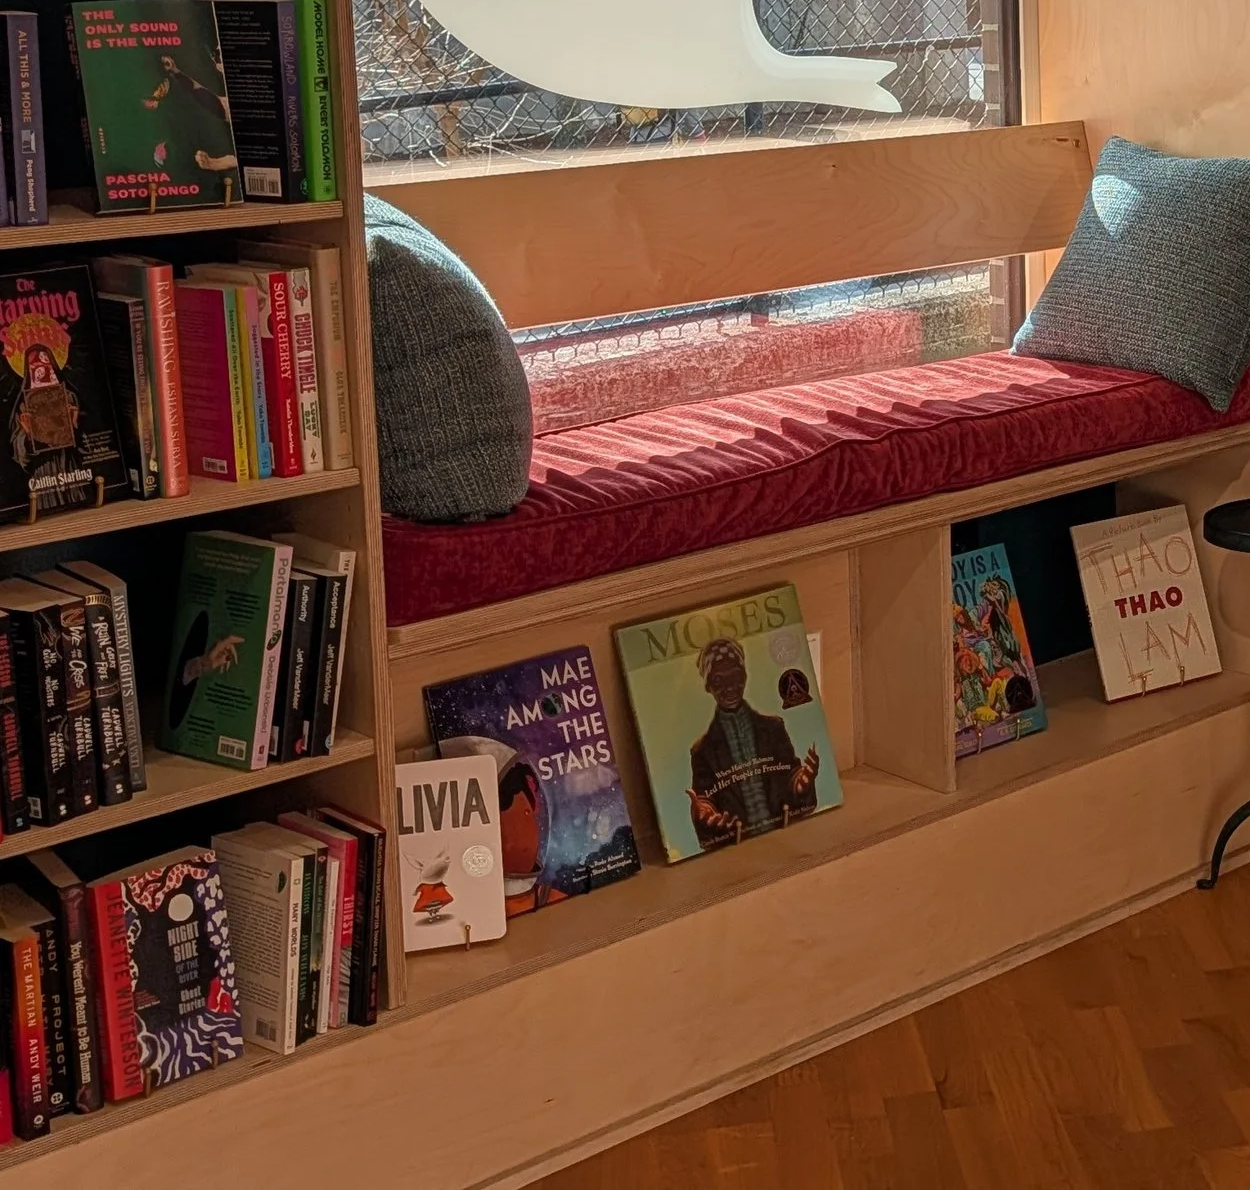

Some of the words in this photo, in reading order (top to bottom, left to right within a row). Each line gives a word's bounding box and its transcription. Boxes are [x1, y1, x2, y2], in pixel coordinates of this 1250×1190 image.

[83, 10, 115, 21] THE
[85, 25, 125, 35] ONLY
[129, 22, 179, 33] SOUND
[17, 30, 28, 52] ALL
[87, 39, 102, 49] IS
[106, 37, 138, 48] THE
[141, 36, 182, 46] WIND
[19, 53, 29, 78] THIS
[20, 92, 32, 123] MORE
[314, 1, 323, 41] MODEL
[319, 129, 332, 181] SOLOMON
[105, 172, 171, 185] PASCHA
[108, 185, 199, 199] SOTOONGO
[274, 282, 286, 321] SOUR
[159, 281, 178, 372] RAVISHING
[295, 313, 313, 353] CHUCK
[277, 323, 292, 379] CHERRY
[299, 354, 316, 394] TINGLE
[1078, 533, 1193, 595] THAO
[114, 595, 128, 648] MYSTERY
[298, 585, 310, 622] Authority
[330, 581, 342, 629] Acceptance
[1114, 586, 1184, 619] THAO
[640, 595, 788, 663] MOSES
[1119, 613, 1206, 685] LAM
[120, 648, 133, 696] LIGHTS
[293, 666, 303, 710] VanderMeer
[323, 663, 334, 705] VanderMeer
[541, 657, 592, 690] MAE
[101, 706, 115, 755] TURNBULL
[111, 708, 125, 752] CADWELL
[558, 712, 605, 744] THE
[537, 740, 611, 781] STARS
[705, 784, 717, 797] Led
[718, 778, 731, 789] Her
[732, 770, 753, 782] People
[763, 762, 791, 773] Freedom
[398, 777, 491, 835] LIVIA
[167, 921, 199, 946] NIGHT
[342, 894, 354, 935] THIRST
[46, 929, 58, 972] ANDY
[107, 895, 129, 982] JEANETTE
[173, 940, 198, 963] SIDE
[22, 947, 33, 971] THE
[24, 974, 37, 1028] MARTIAN
[75, 995, 87, 1025] Meant
[28, 1038, 40, 1069] ANDY
[116, 988, 142, 1087] WINTERSON
[32, 1071, 43, 1103] WEIR
[80, 1051, 91, 1084] Human
